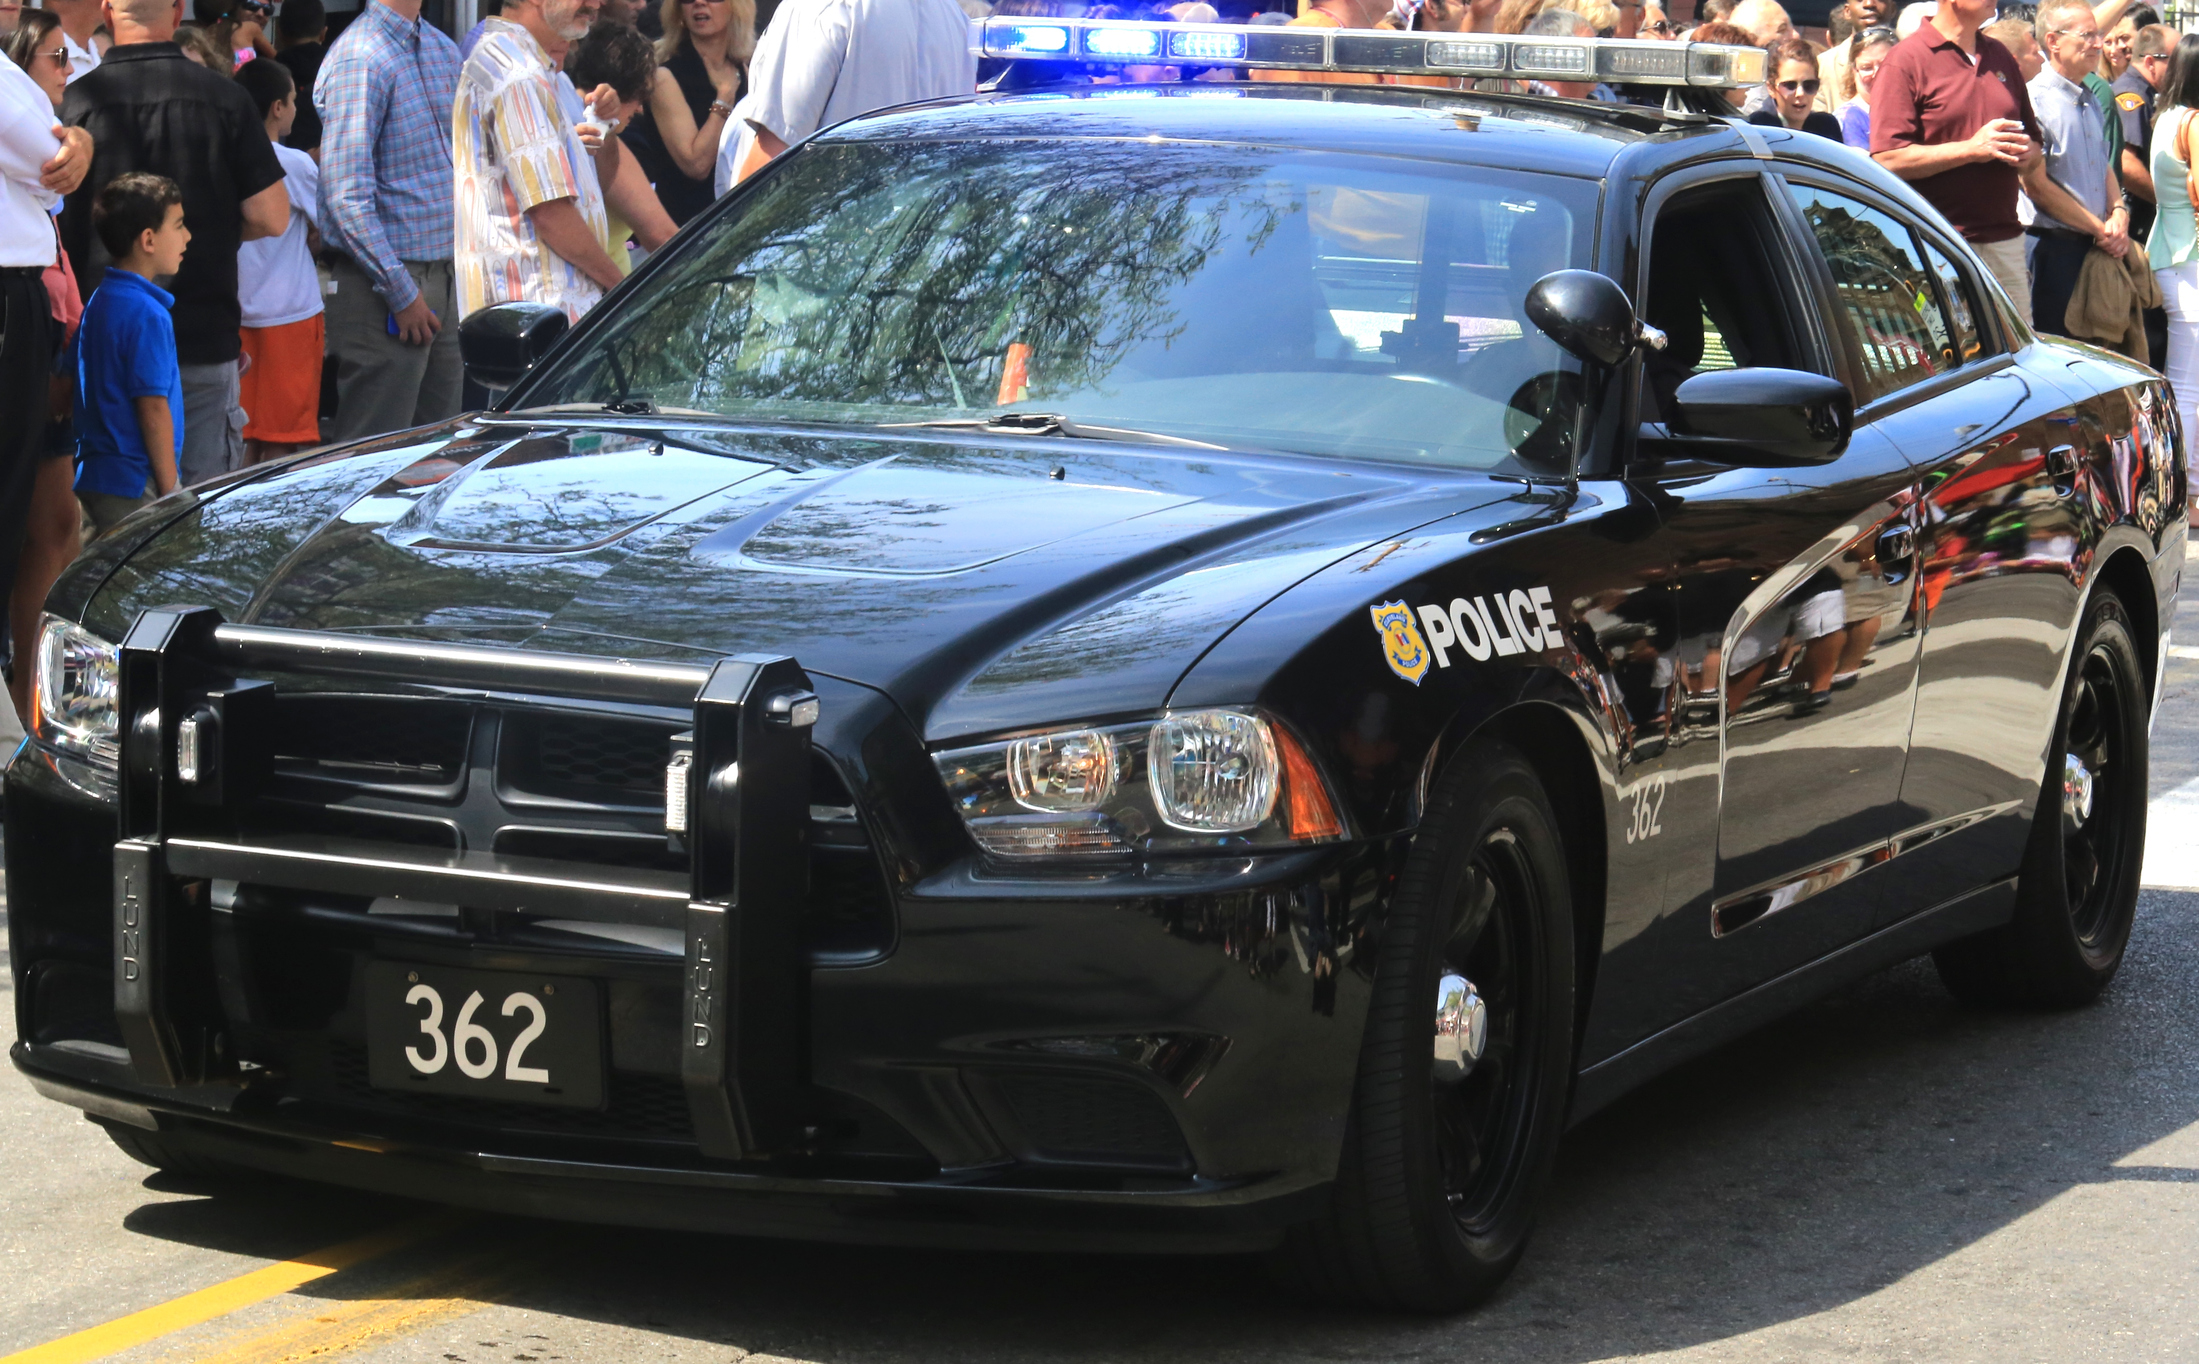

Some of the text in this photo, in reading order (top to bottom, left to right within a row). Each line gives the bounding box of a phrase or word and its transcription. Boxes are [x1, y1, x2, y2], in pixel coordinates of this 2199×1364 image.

[1402, 659, 1418, 667] POLICE
[1417, 586, 1564, 668] POLICE
[1627, 775, 1665, 844] 362
[123, 875, 140, 982] LUND
[405, 984, 549, 1083] 362
[693, 938, 713, 1047] LUND
